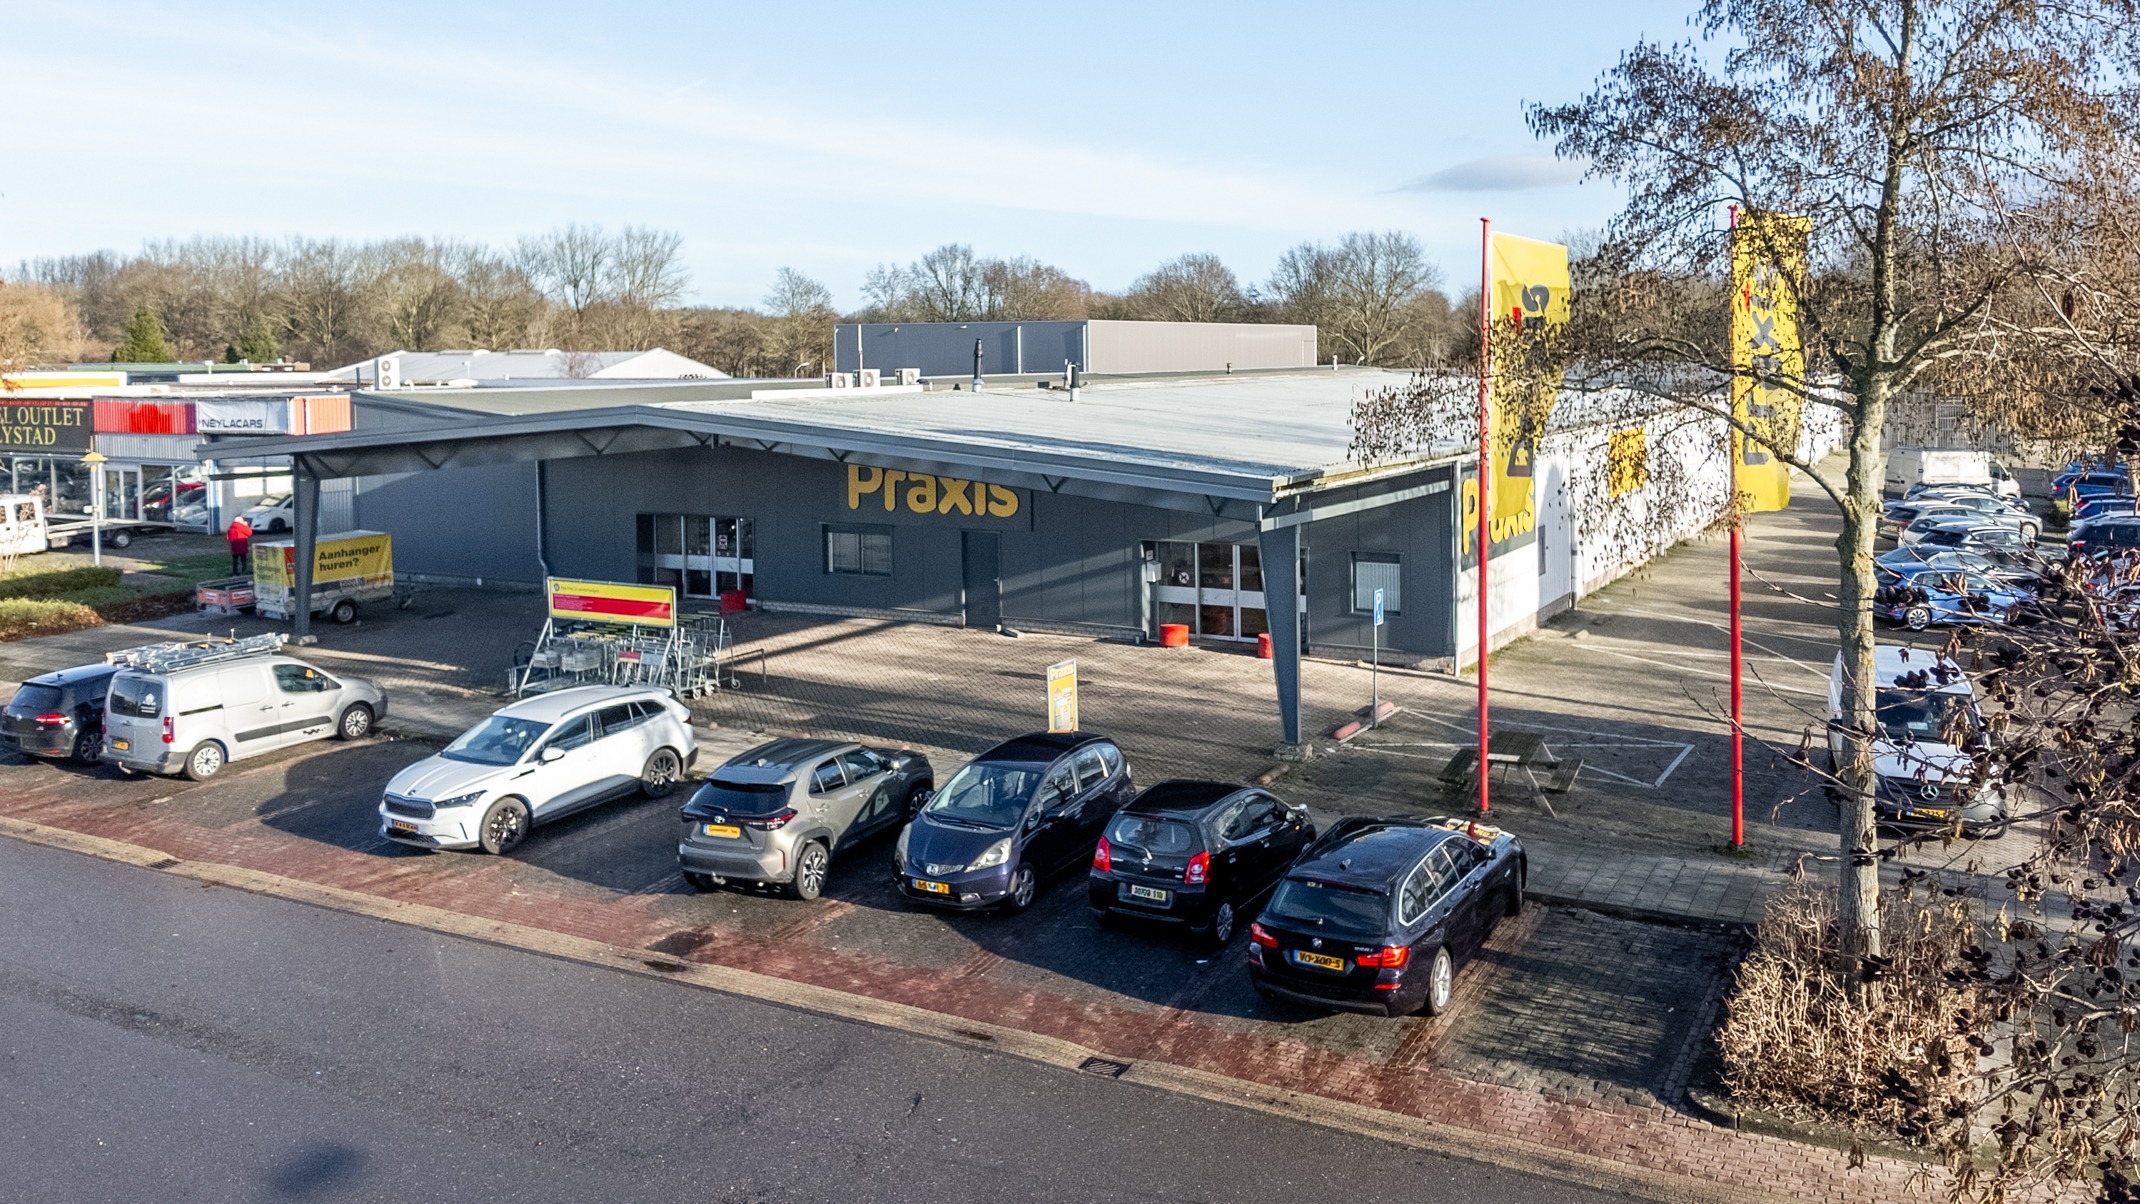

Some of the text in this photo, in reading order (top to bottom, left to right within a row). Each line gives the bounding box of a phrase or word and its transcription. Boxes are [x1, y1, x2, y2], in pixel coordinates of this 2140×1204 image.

[17, 406, 84, 427] OUTLET
[0, 426, 57, 446] YSTAD
[848, 463, 1019, 518] Praxis
[319, 545, 381, 561] Aanhanger
[319, 557, 360, 572] huren?
